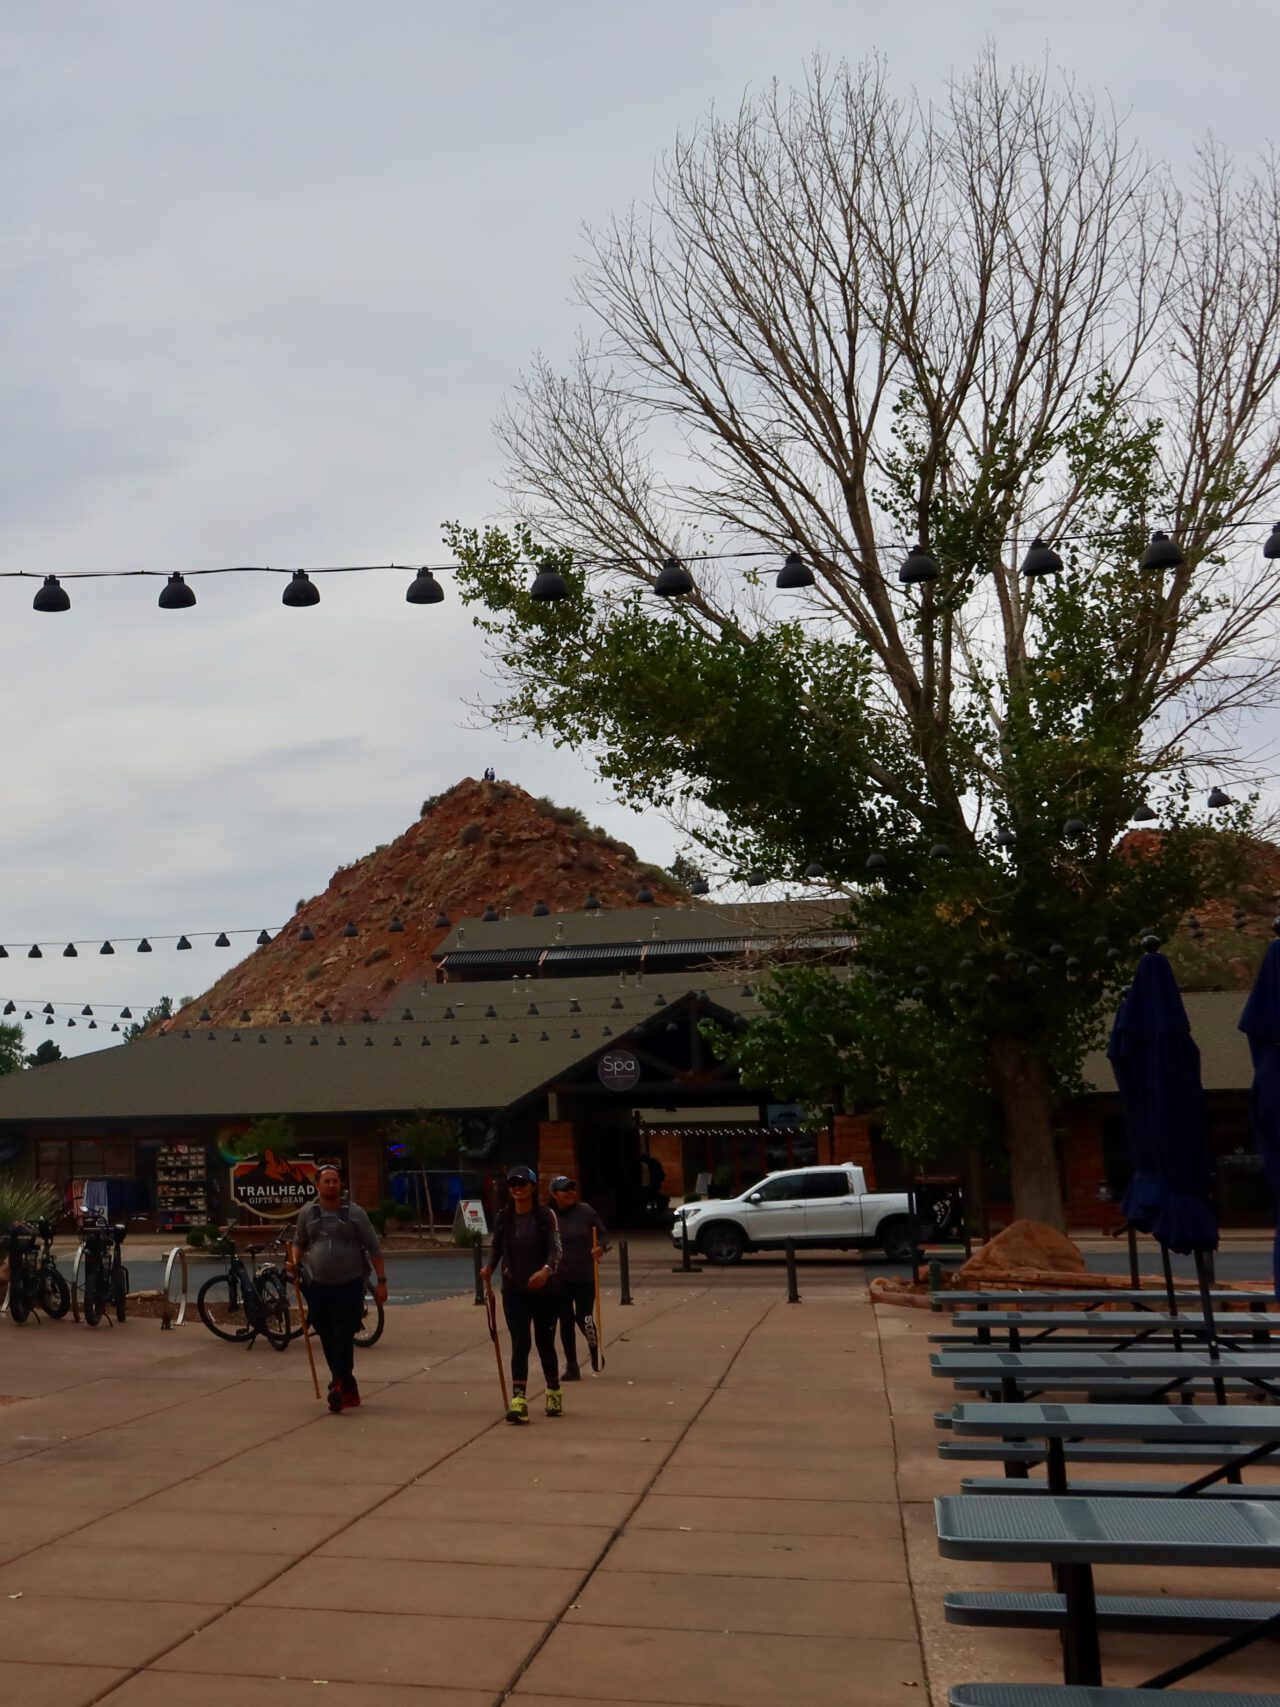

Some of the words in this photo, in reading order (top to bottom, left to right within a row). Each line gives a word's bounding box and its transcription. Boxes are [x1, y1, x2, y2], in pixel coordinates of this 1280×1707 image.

[603, 1056, 635, 1076] Spa
[237, 1185, 316, 1197] TRAILHEAD
[249, 1197, 273, 1205] GIFTS
[283, 1196, 304, 1204] GEAR
